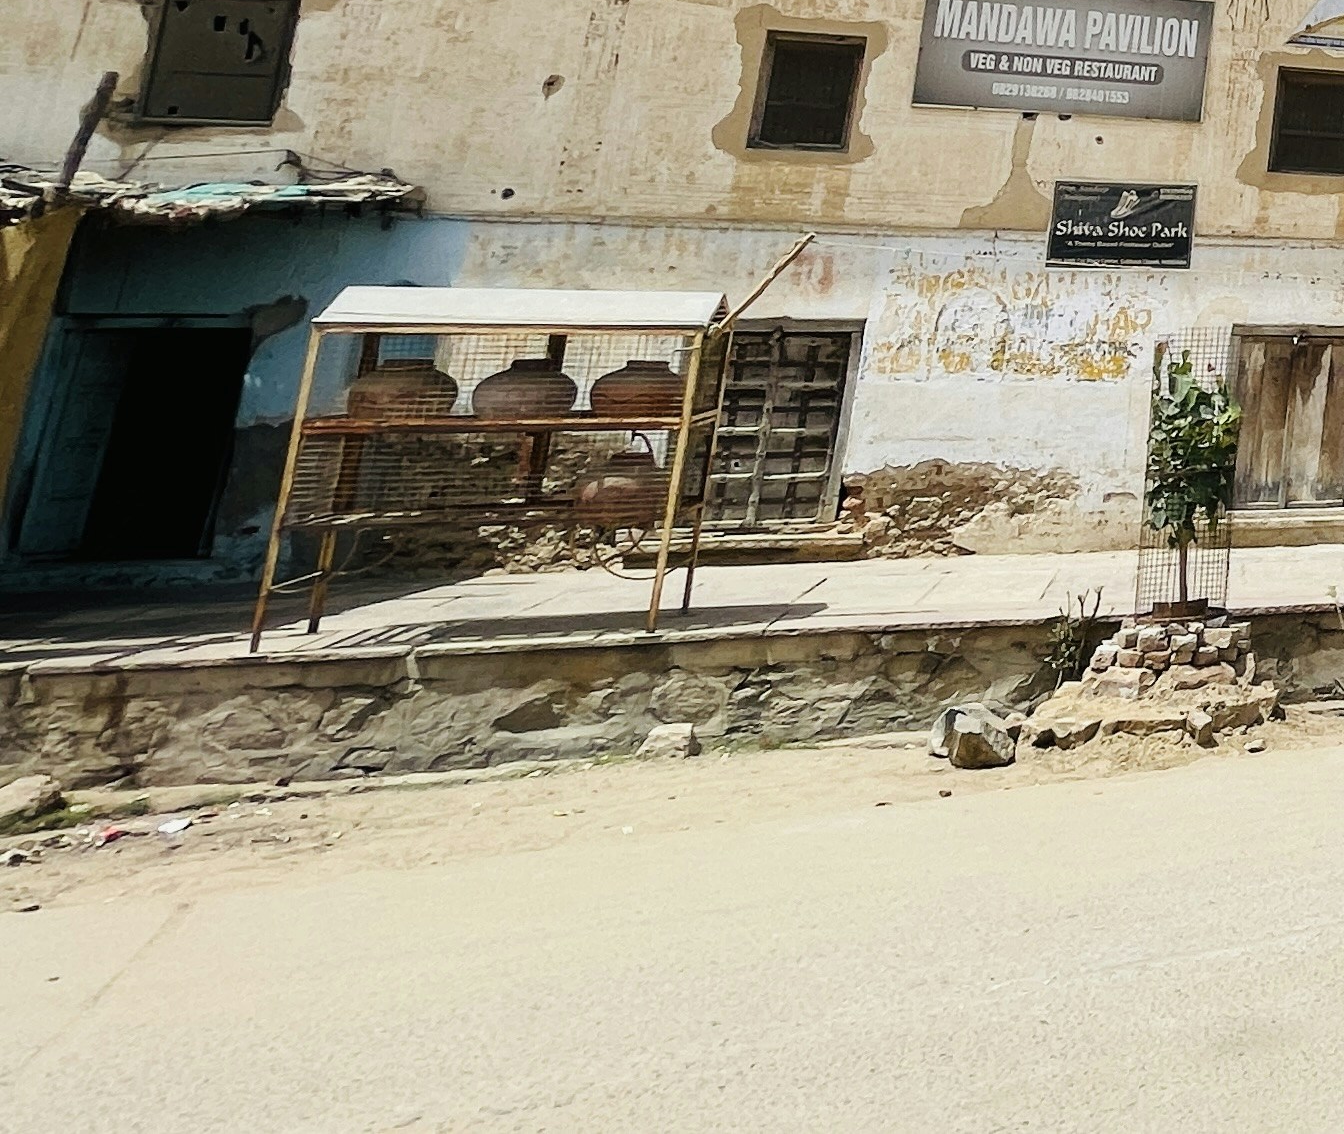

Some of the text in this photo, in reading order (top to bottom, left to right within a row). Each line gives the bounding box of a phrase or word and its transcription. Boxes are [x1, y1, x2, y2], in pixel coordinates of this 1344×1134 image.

[1083, 10, 1200, 58] PAVILION
[969, 52, 1158, 82] VEG & NON VEG RESTAURANT
[1055, 219, 1188, 238] Shiva Shoe Park
